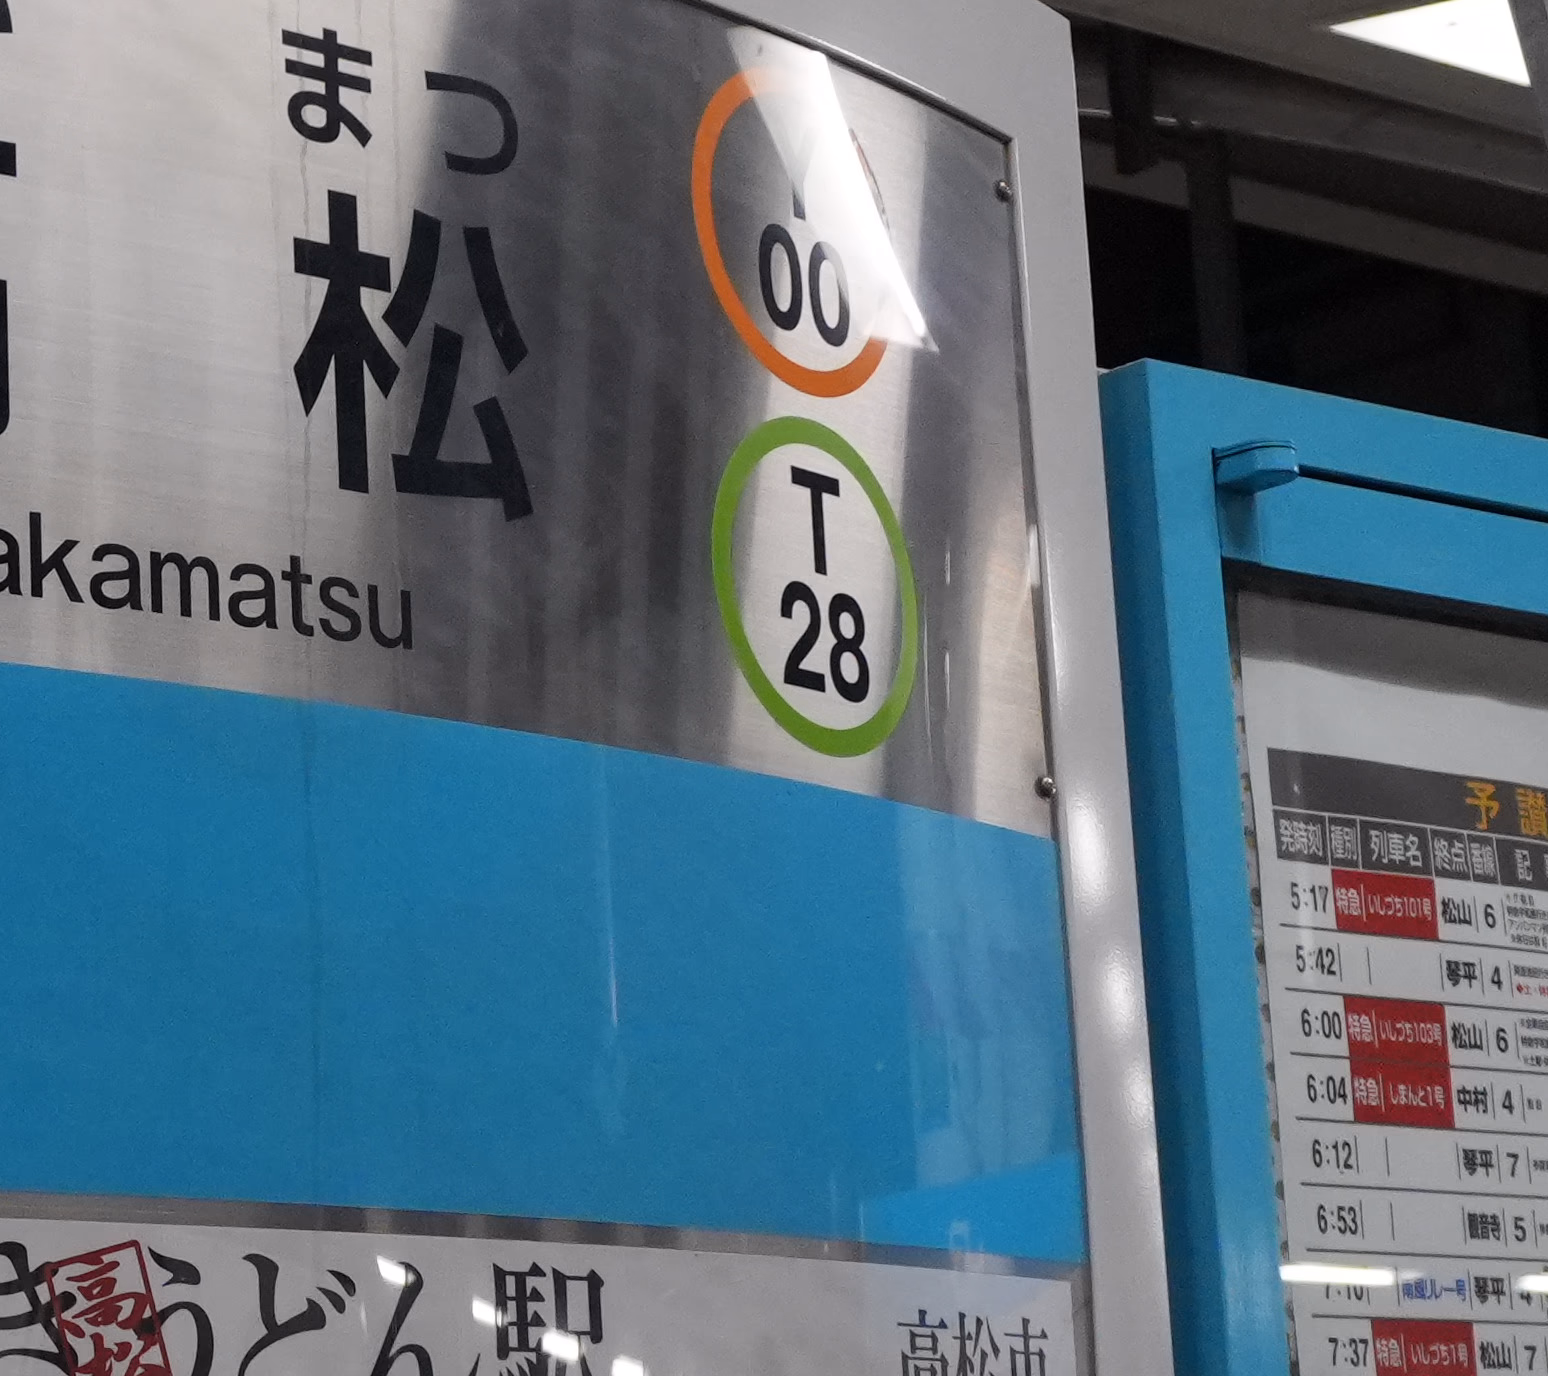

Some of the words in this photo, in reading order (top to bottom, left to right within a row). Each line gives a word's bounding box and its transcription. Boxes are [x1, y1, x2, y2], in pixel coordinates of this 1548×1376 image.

[790, 465, 840, 576] T
[779, 580, 870, 705] 28
[1290, 881, 1329, 913] 5:17
[1295, 945, 1336, 975] 5:42
[1301, 1008, 1343, 1039] 6:00
[1307, 1075, 1348, 1104] 6:04
[1312, 1138, 1353, 1170] 6:12
[1317, 1204, 1358, 1235] 6:53
[1328, 1337, 1368, 1367] 7:37
